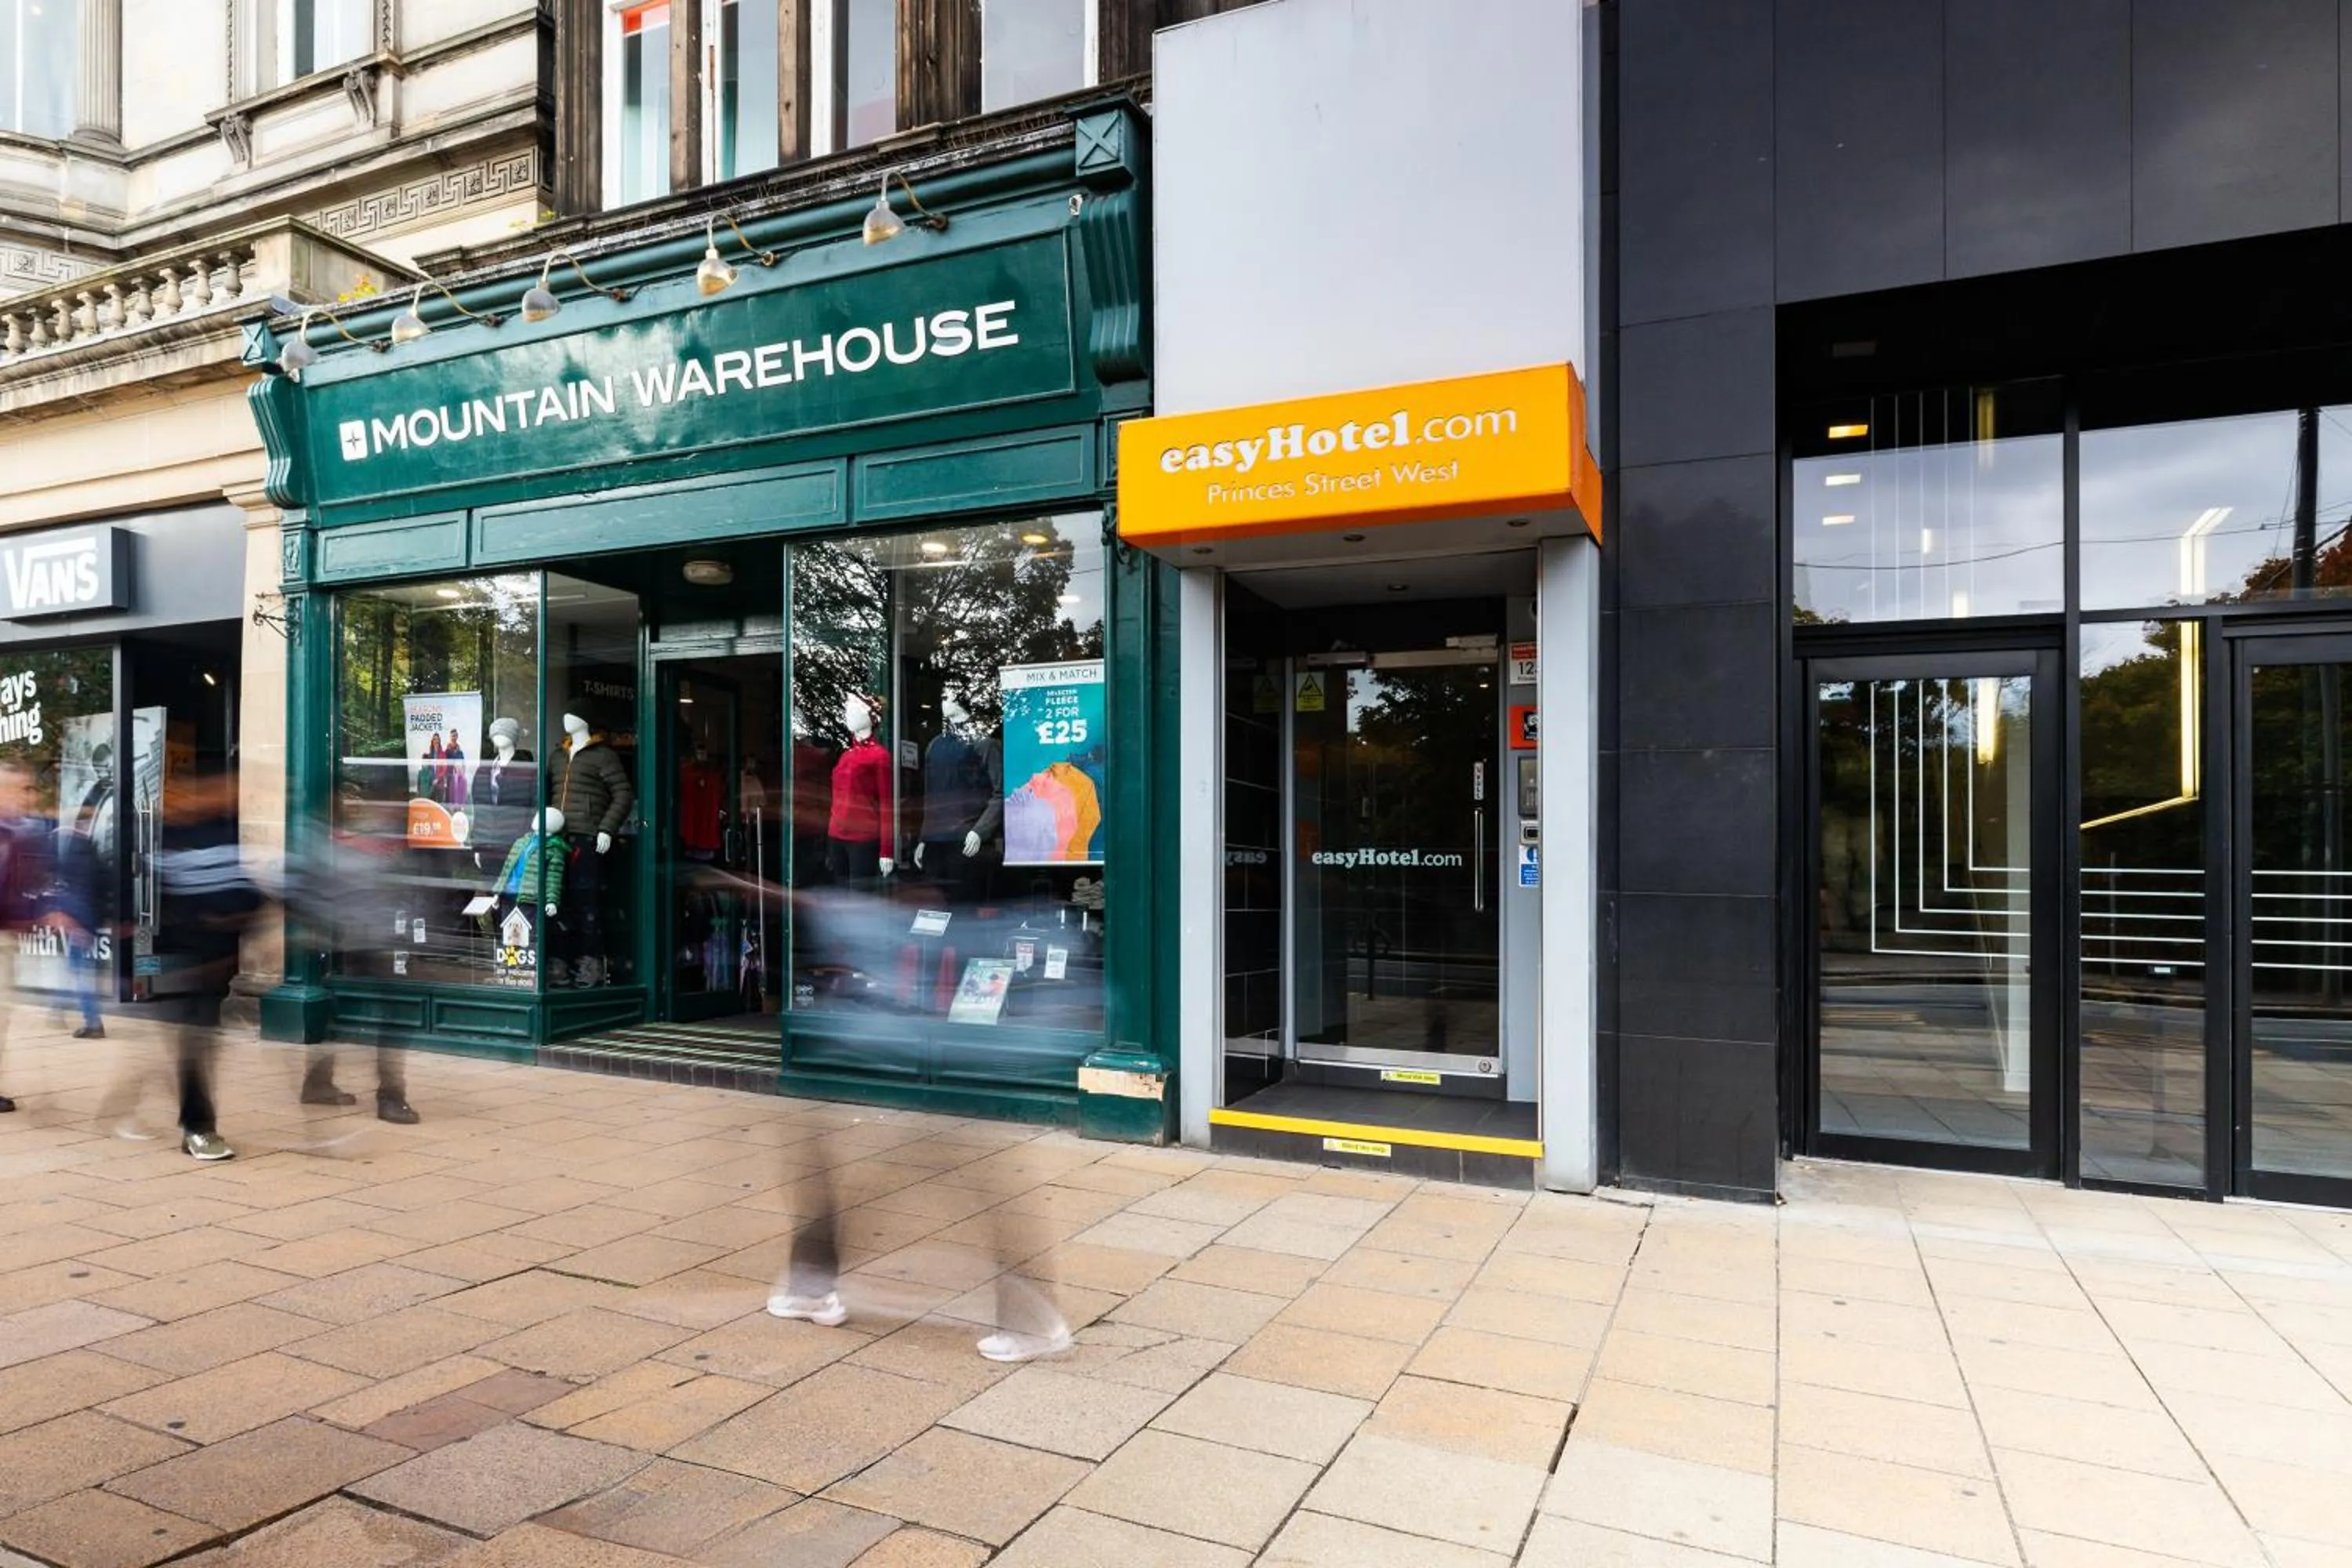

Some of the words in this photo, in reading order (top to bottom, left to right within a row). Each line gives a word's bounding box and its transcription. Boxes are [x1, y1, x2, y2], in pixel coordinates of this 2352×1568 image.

[373, 376, 616, 455] MOUNTAIN
[632, 299, 1020, 408] WAREHOUSE
[1160, 407, 1518, 474] easyHotel.com
[1208, 479, 1296, 506] Princes
[1305, 466, 1382, 497] Street
[1390, 460, 1460, 485] West
[4, 537, 99, 609] VANS
[1026, 672, 1045, 681] MIX
[1059, 668, 1098, 681] MATCH
[1045, 695, 1079, 705] FLEECE
[410, 713, 443, 722] PADDED
[1045, 708, 1053, 719] 2
[1055, 706, 1080, 717] FOR
[409, 722, 443, 731] JACKETS
[1037, 718, 1087, 745] £25
[1312, 848, 1463, 869] easyHotel.com
[18, 925, 58, 956] with
[496, 946, 536, 966] DGS
